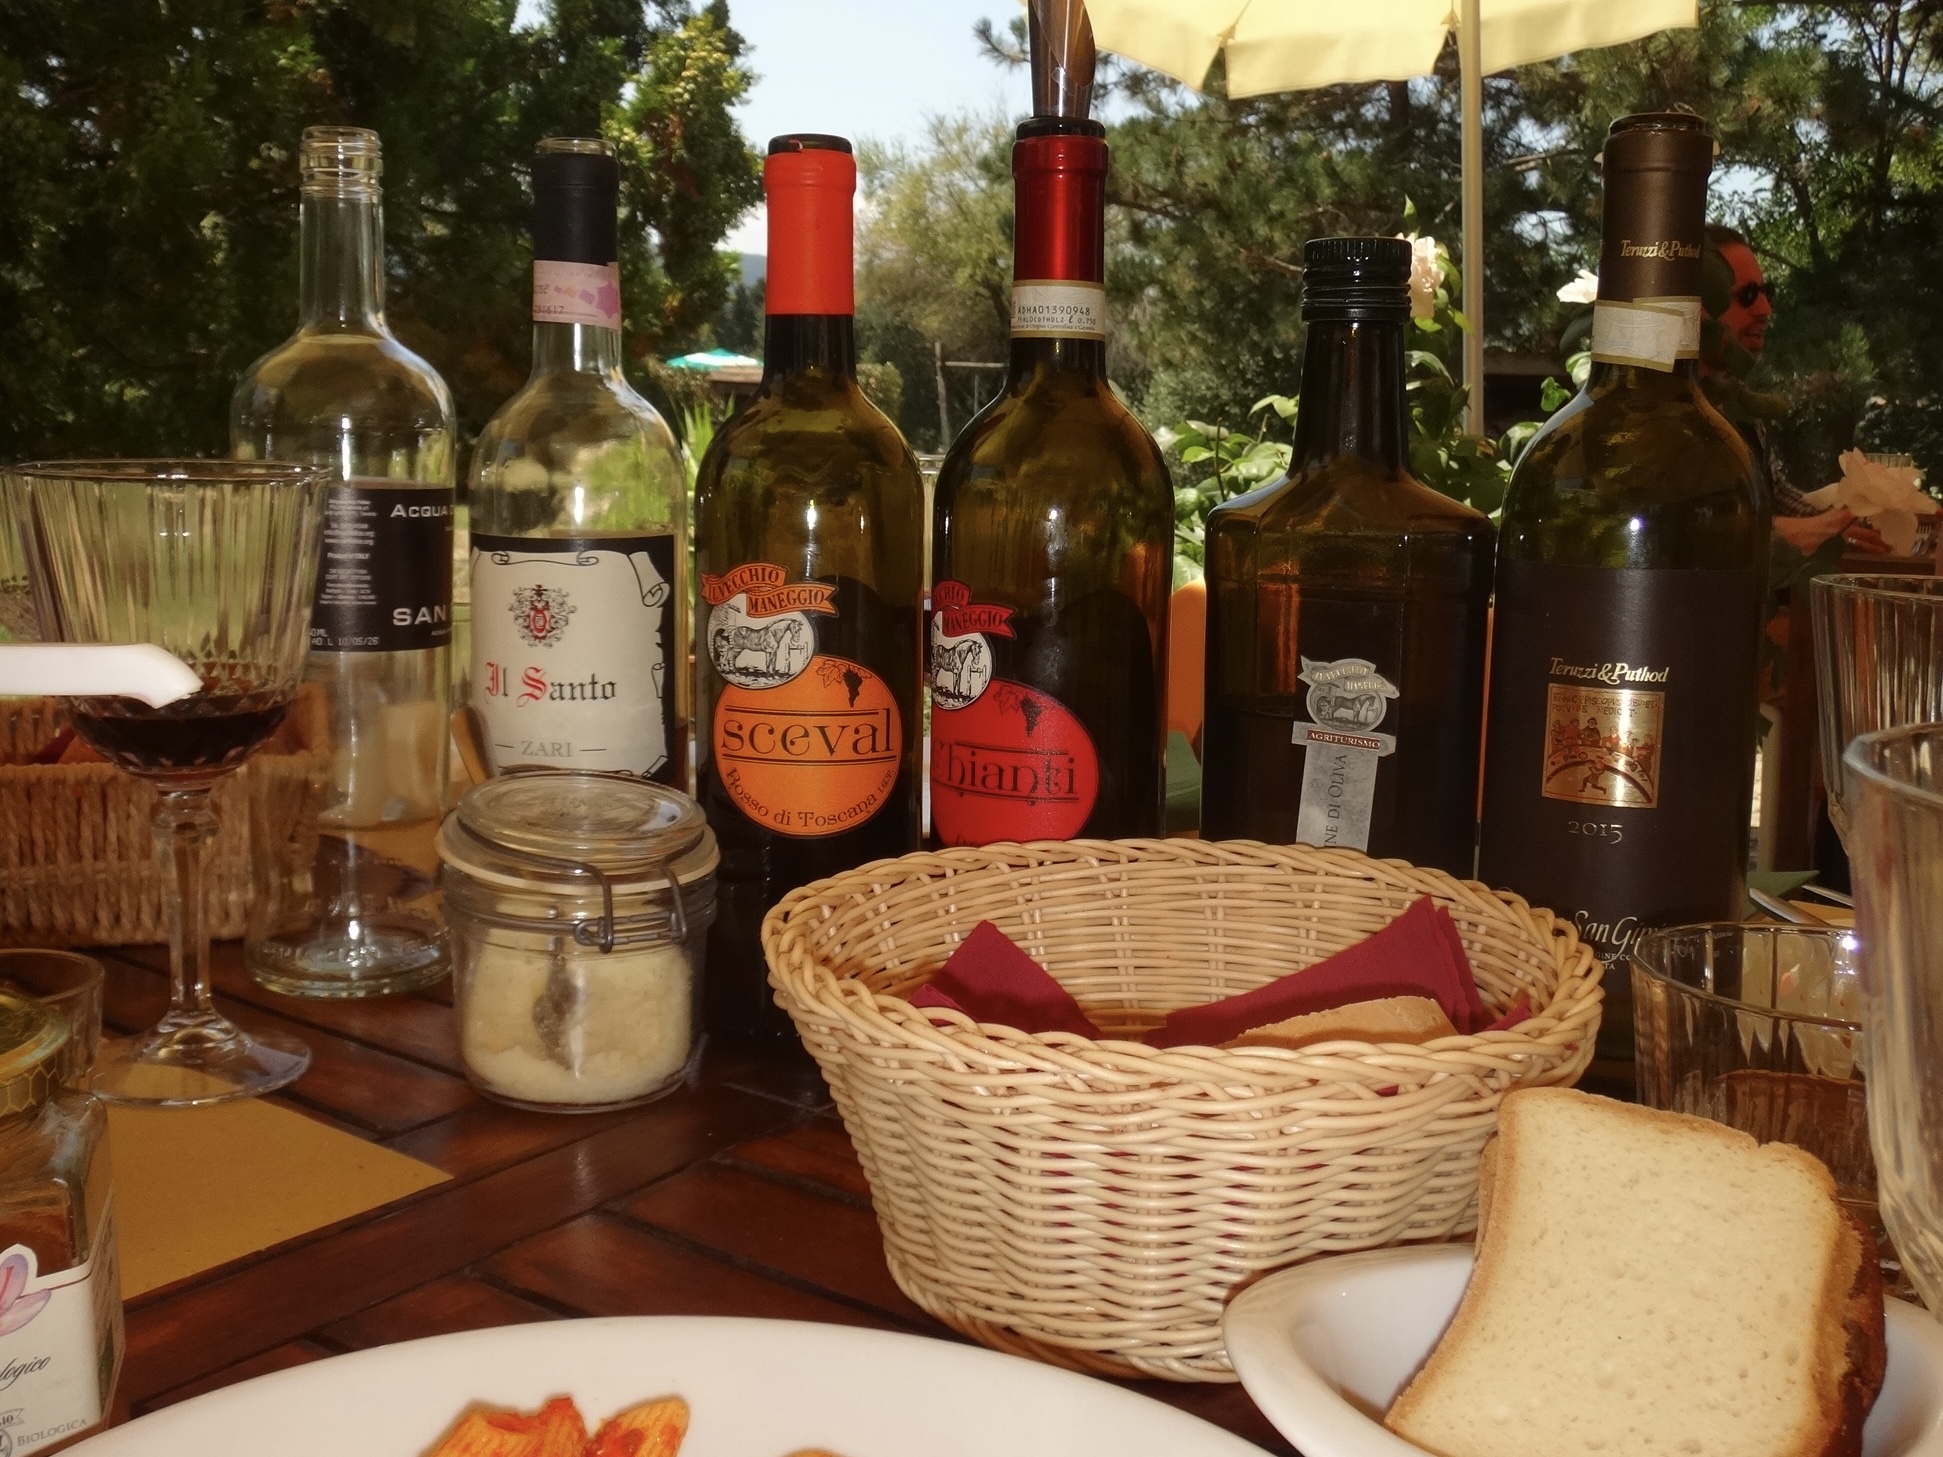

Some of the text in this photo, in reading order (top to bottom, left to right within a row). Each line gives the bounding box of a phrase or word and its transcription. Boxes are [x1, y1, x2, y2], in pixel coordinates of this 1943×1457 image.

[717, 567, 780, 600] VECCHIO
[747, 589, 825, 613] MANEGGIO
[392, 604, 447, 626] SAN
[516, 666, 617, 708] Santo
[720, 708, 894, 757] sceval
[1309, 731, 1381, 749] AGRITURISMO
[521, 740, 573, 758] ZARI
[726, 768, 769, 818] Rosso
[774, 809, 792, 826] di
[797, 793, 878, 828] Toscana
[1327, 803, 1341, 820] DI
[1568, 820, 1624, 845] 2015
[17, 1418, 88, 1447] BIOLOGICA
